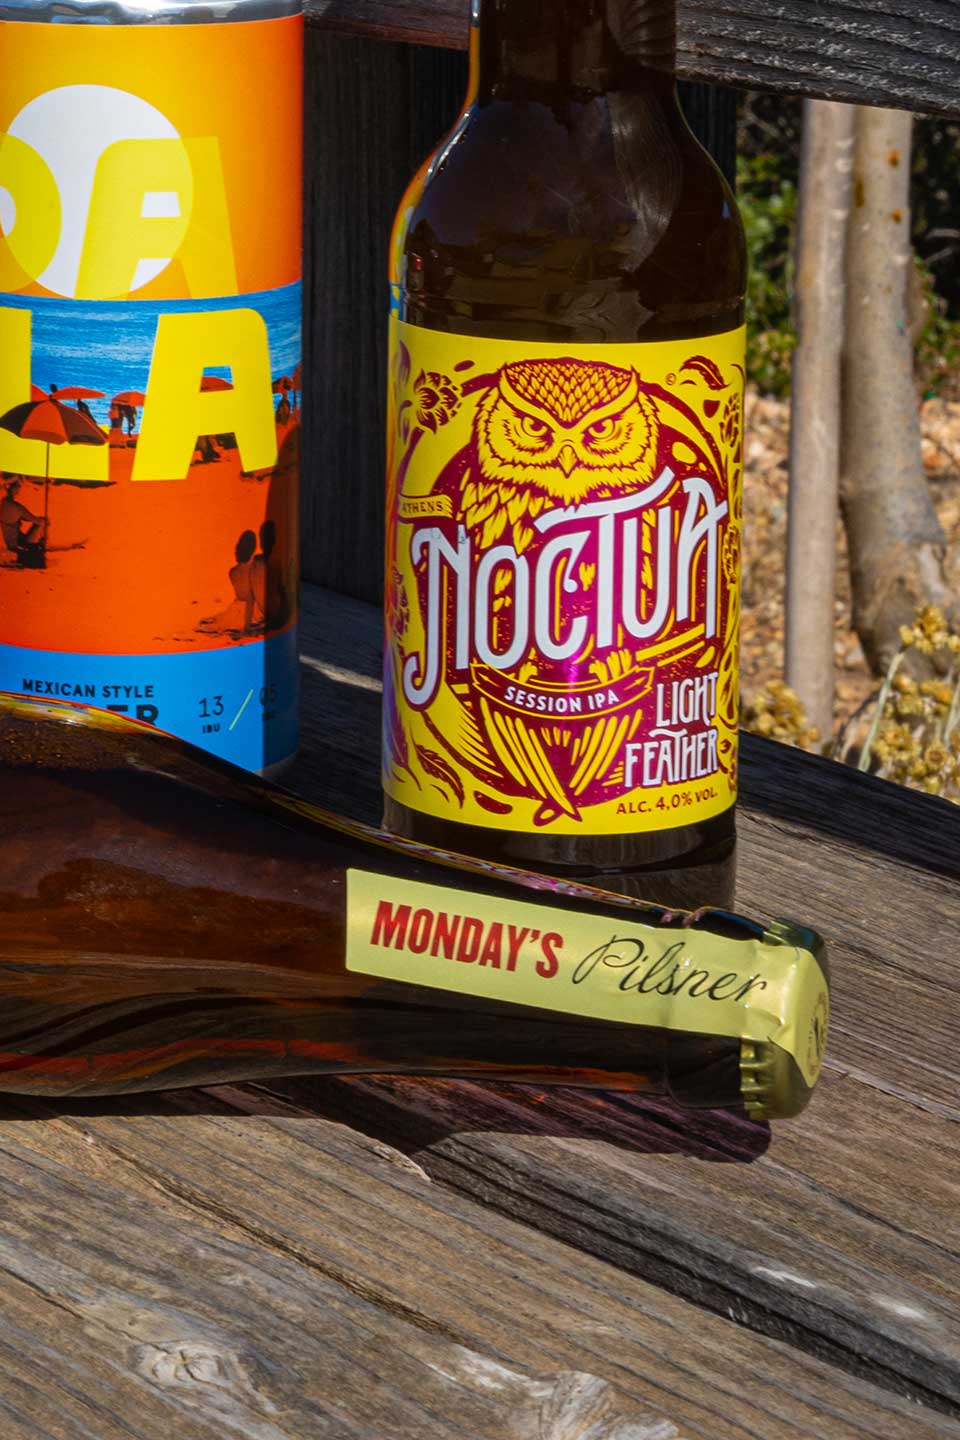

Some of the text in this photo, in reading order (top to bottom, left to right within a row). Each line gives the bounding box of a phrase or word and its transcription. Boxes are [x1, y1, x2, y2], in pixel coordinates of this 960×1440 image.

[403, 465, 729, 707] NOCTUA
[22, 678, 154, 699] MEXICAN STYLE
[504, 686, 620, 713] SESSION IPA
[655, 672, 719, 728] LIGHT
[198, 695, 225, 718] 13
[202, 723, 220, 734] IBU
[625, 728, 719, 788] FEATHER
[616, 802, 652, 816] ALC.
[696, 787, 718, 803] VOL.
[370, 900, 767, 1003] MONDAY'S Pilsner
